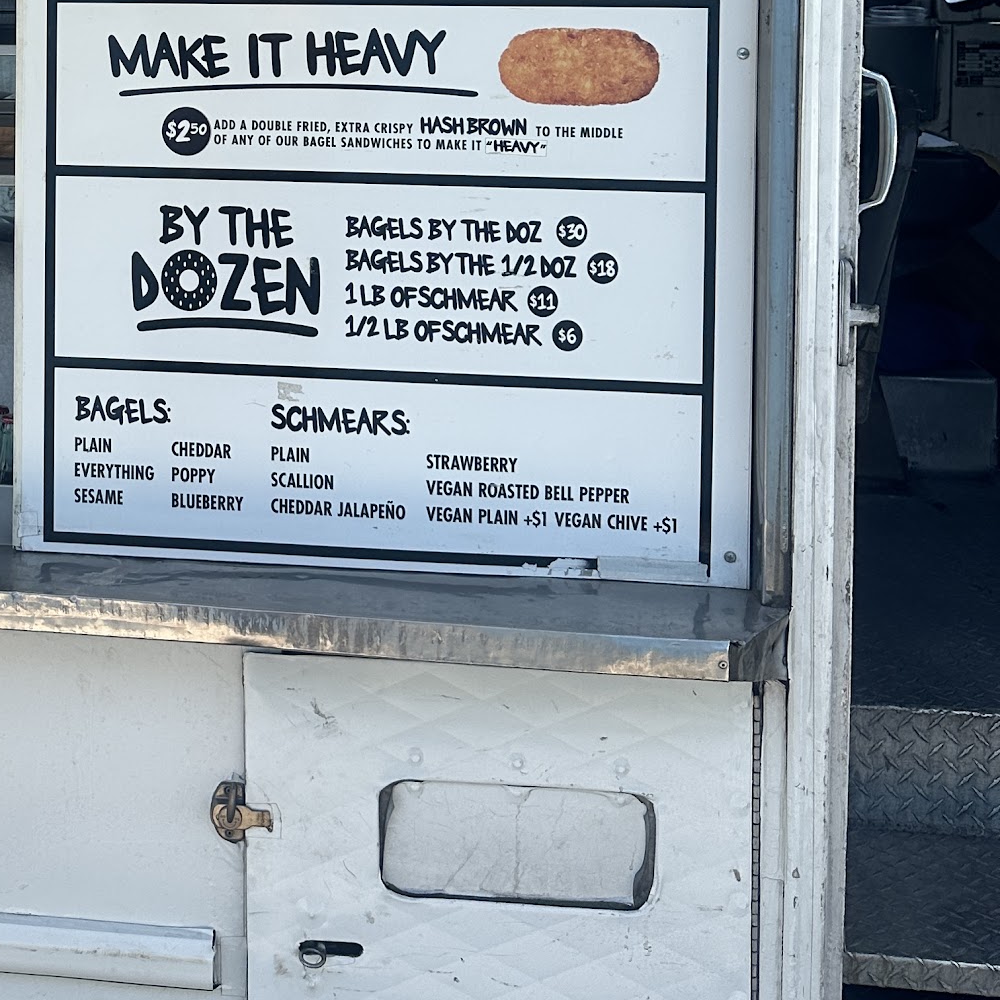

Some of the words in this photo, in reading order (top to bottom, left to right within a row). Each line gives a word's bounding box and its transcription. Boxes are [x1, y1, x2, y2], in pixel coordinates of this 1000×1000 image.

[107, 31, 229, 79] MAKE
[248, 32, 292, 78] IT
[306, 27, 446, 76] HEAVY
[213, 119, 235, 129] ADD
[239, 119, 246, 130] A
[251, 119, 291, 131] DOUBLE
[296, 120, 330, 134] FRIED,
[335, 121, 369, 132] EXTRA
[374, 122, 413, 133] CRISPY
[535, 125, 550, 136] TO
[554, 126, 575, 137] THE
[579, 126, 623, 138] MIDDLE
[213, 133, 227, 144] OF
[231, 134, 253, 145] ANY
[258, 134, 271, 145] OF
[275, 135, 298, 146] OUR
[303, 136, 336, 147] BAGEL
[340, 136, 412, 149] SANDWICHES
[416, 138, 431, 149] TO
[435, 138, 466, 150] MAKE
[471, 139, 481, 150] IT
[158, 204, 209, 245] BY
[218, 205, 293, 247] THE
[345, 215, 423, 240] BAGELS
[427, 218, 456, 241] BY
[460, 218, 501, 243] THE
[505, 220, 542, 243] DOZ
[558, 223, 586, 240] $30
[345, 248, 423, 274] BAGELS
[425, 251, 453, 274] BY
[454, 252, 495, 276] THE
[501, 253, 537, 276] 1/2
[540, 255, 576, 278] DOZ
[589, 259, 617, 277] $18
[529, 293, 556, 310] $11
[558, 327, 577, 344] $6
[74, 394, 170, 425] BAGELS:
[270, 403, 410, 436] SCHMEARS:
[74, 436, 111, 452] PLAIN
[171, 441, 231, 458] CHEDDAR
[271, 445, 309, 463] PLAIN
[426, 453, 517, 472] STRAWBERRY
[74, 462, 154, 480] EVERYTHING
[171, 466, 215, 483] POPPY
[270, 471, 333, 490] SCALLION
[74, 487, 123, 505] SESAME
[425, 479, 472, 496] VEGAN
[478, 482, 539, 499] ROASTED
[544, 485, 573, 501] BELL
[579, 486, 629, 503] PEPPER
[171, 492, 243, 511] BLUEBERRY
[270, 498, 332, 516] CHEDDAR
[337, 500, 405, 520] JALAPEÑO
[425, 506, 472, 523] VEGAN
[478, 508, 517, 525] PLAIN
[523, 509, 546, 528] +$1
[554, 511, 601, 528] VEGAN
[607, 514, 647, 531] CHIVE
[653, 516, 676, 534] +$1
